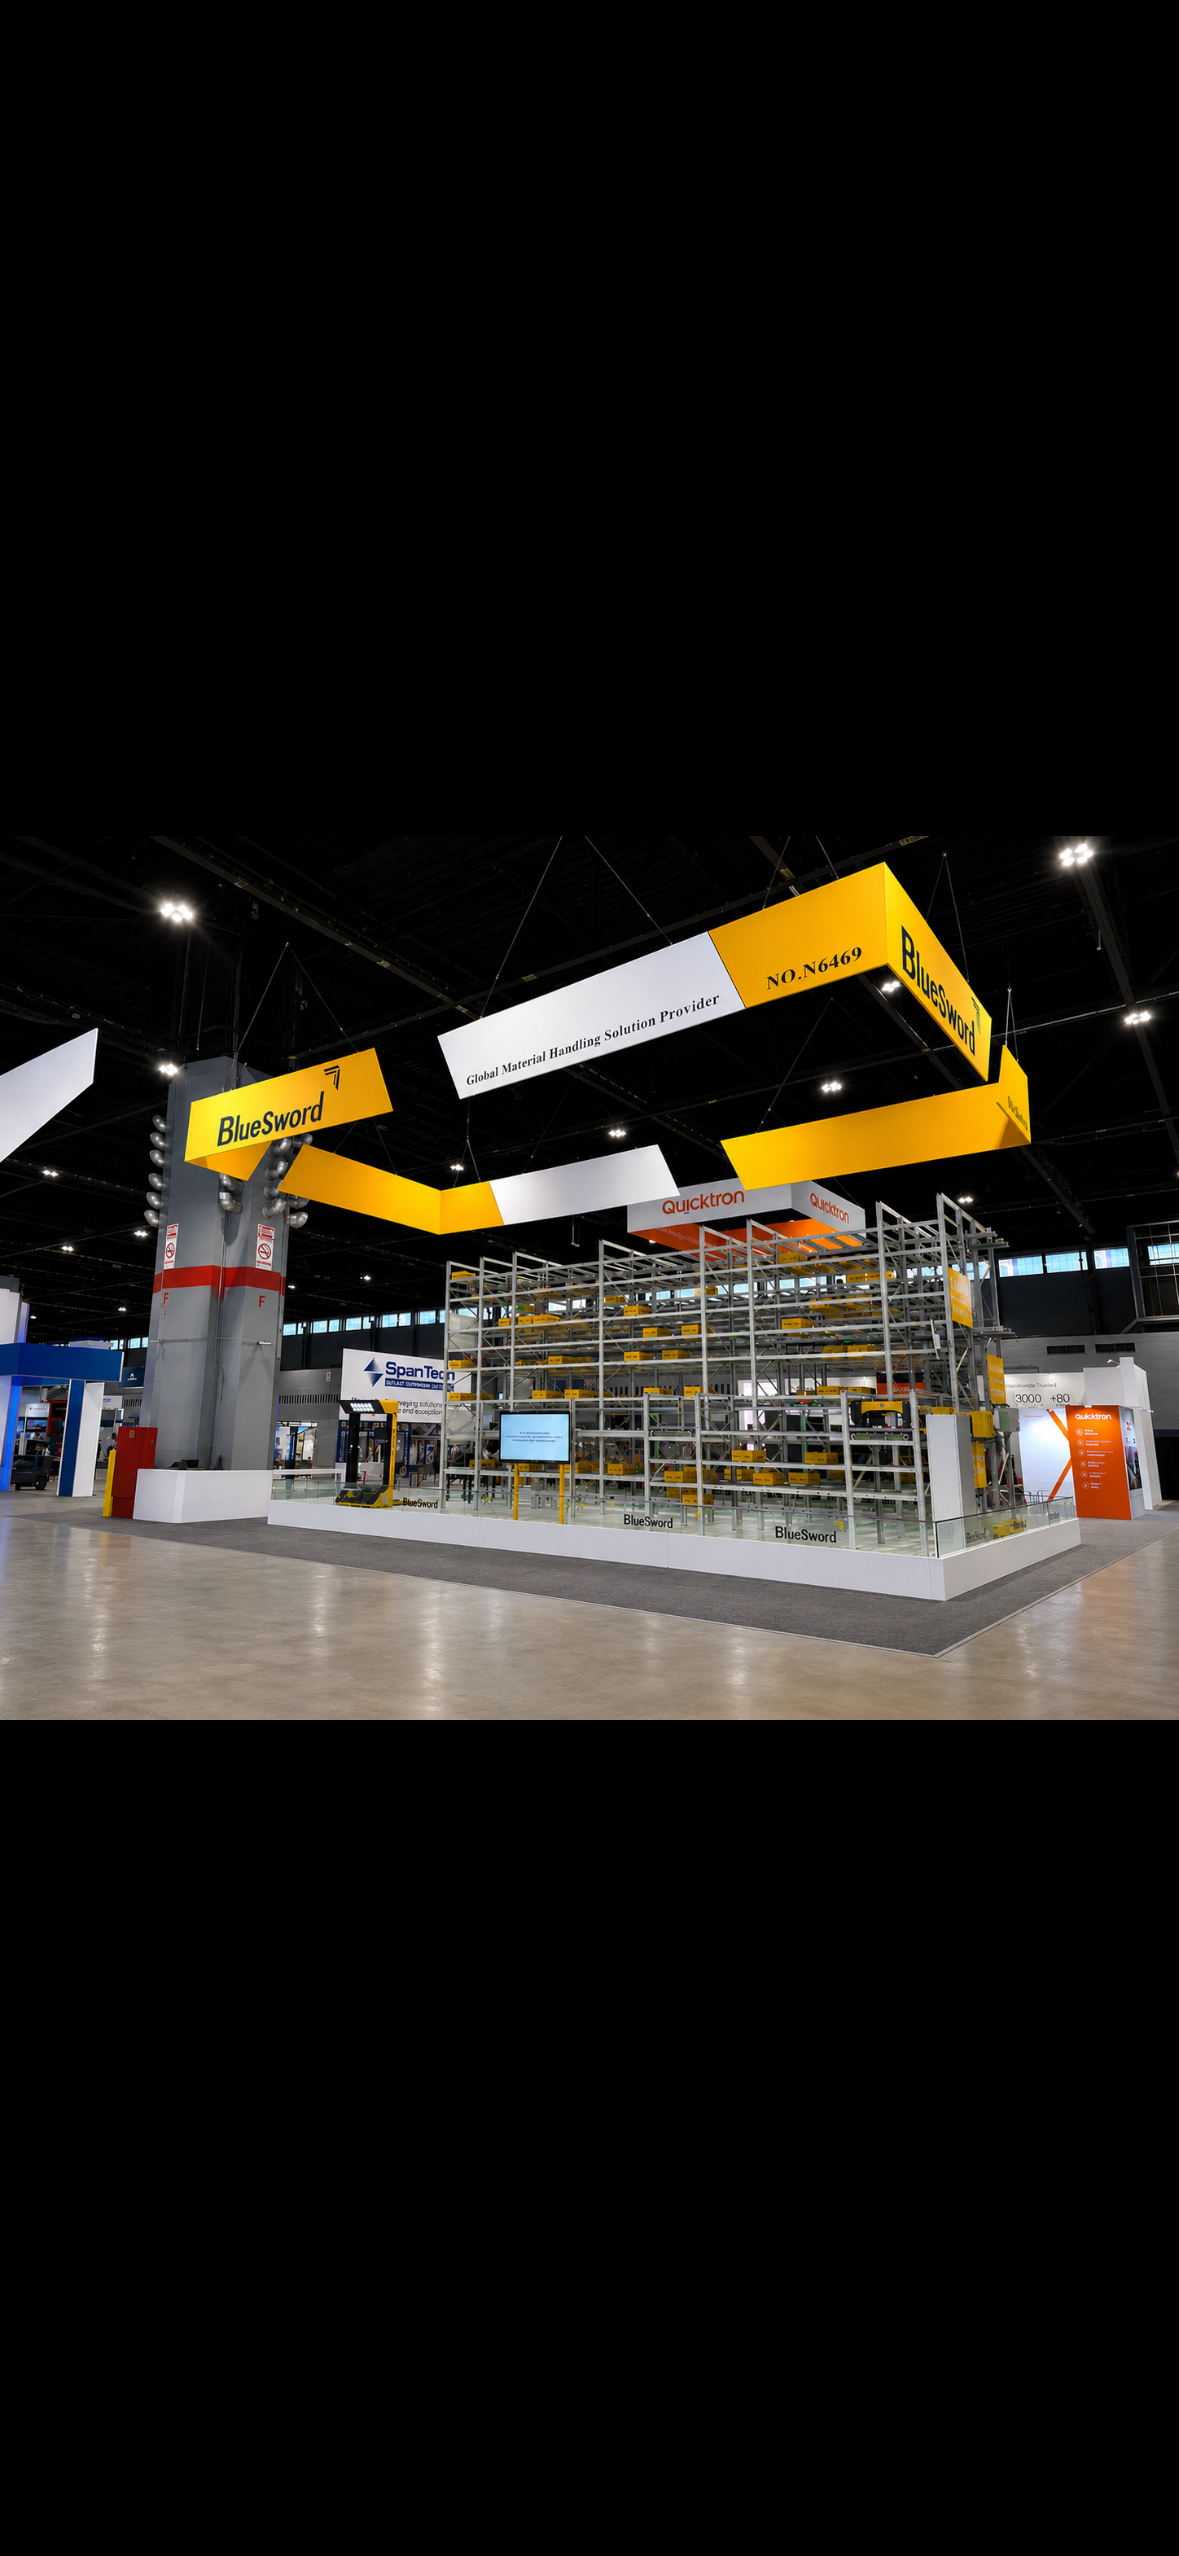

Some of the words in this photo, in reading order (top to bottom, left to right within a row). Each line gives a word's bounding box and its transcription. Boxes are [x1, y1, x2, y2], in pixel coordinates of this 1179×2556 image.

[766, 946, 862, 990] NO.N6469
[901, 925, 976, 1056] BlueSword
[466, 1066, 499, 1086] Global
[501, 1051, 546, 1075] Material
[549, 1034, 601, 1060] Handling
[604, 1017, 656, 1042] Solution
[659, 994, 720, 1023] Provider
[217, 1091, 325, 1147] BlueSword
[662, 1190, 745, 1215] Quicktron
[810, 1193, 850, 1225] Quicktron
[258, 1294, 266, 1308] F
[1015, 1393, 1042, 1403] 3000
[402, 1497, 438, 1509] BlueSword
[623, 1513, 673, 1529] BlueSword
[775, 1526, 837, 1543] BlueSword
